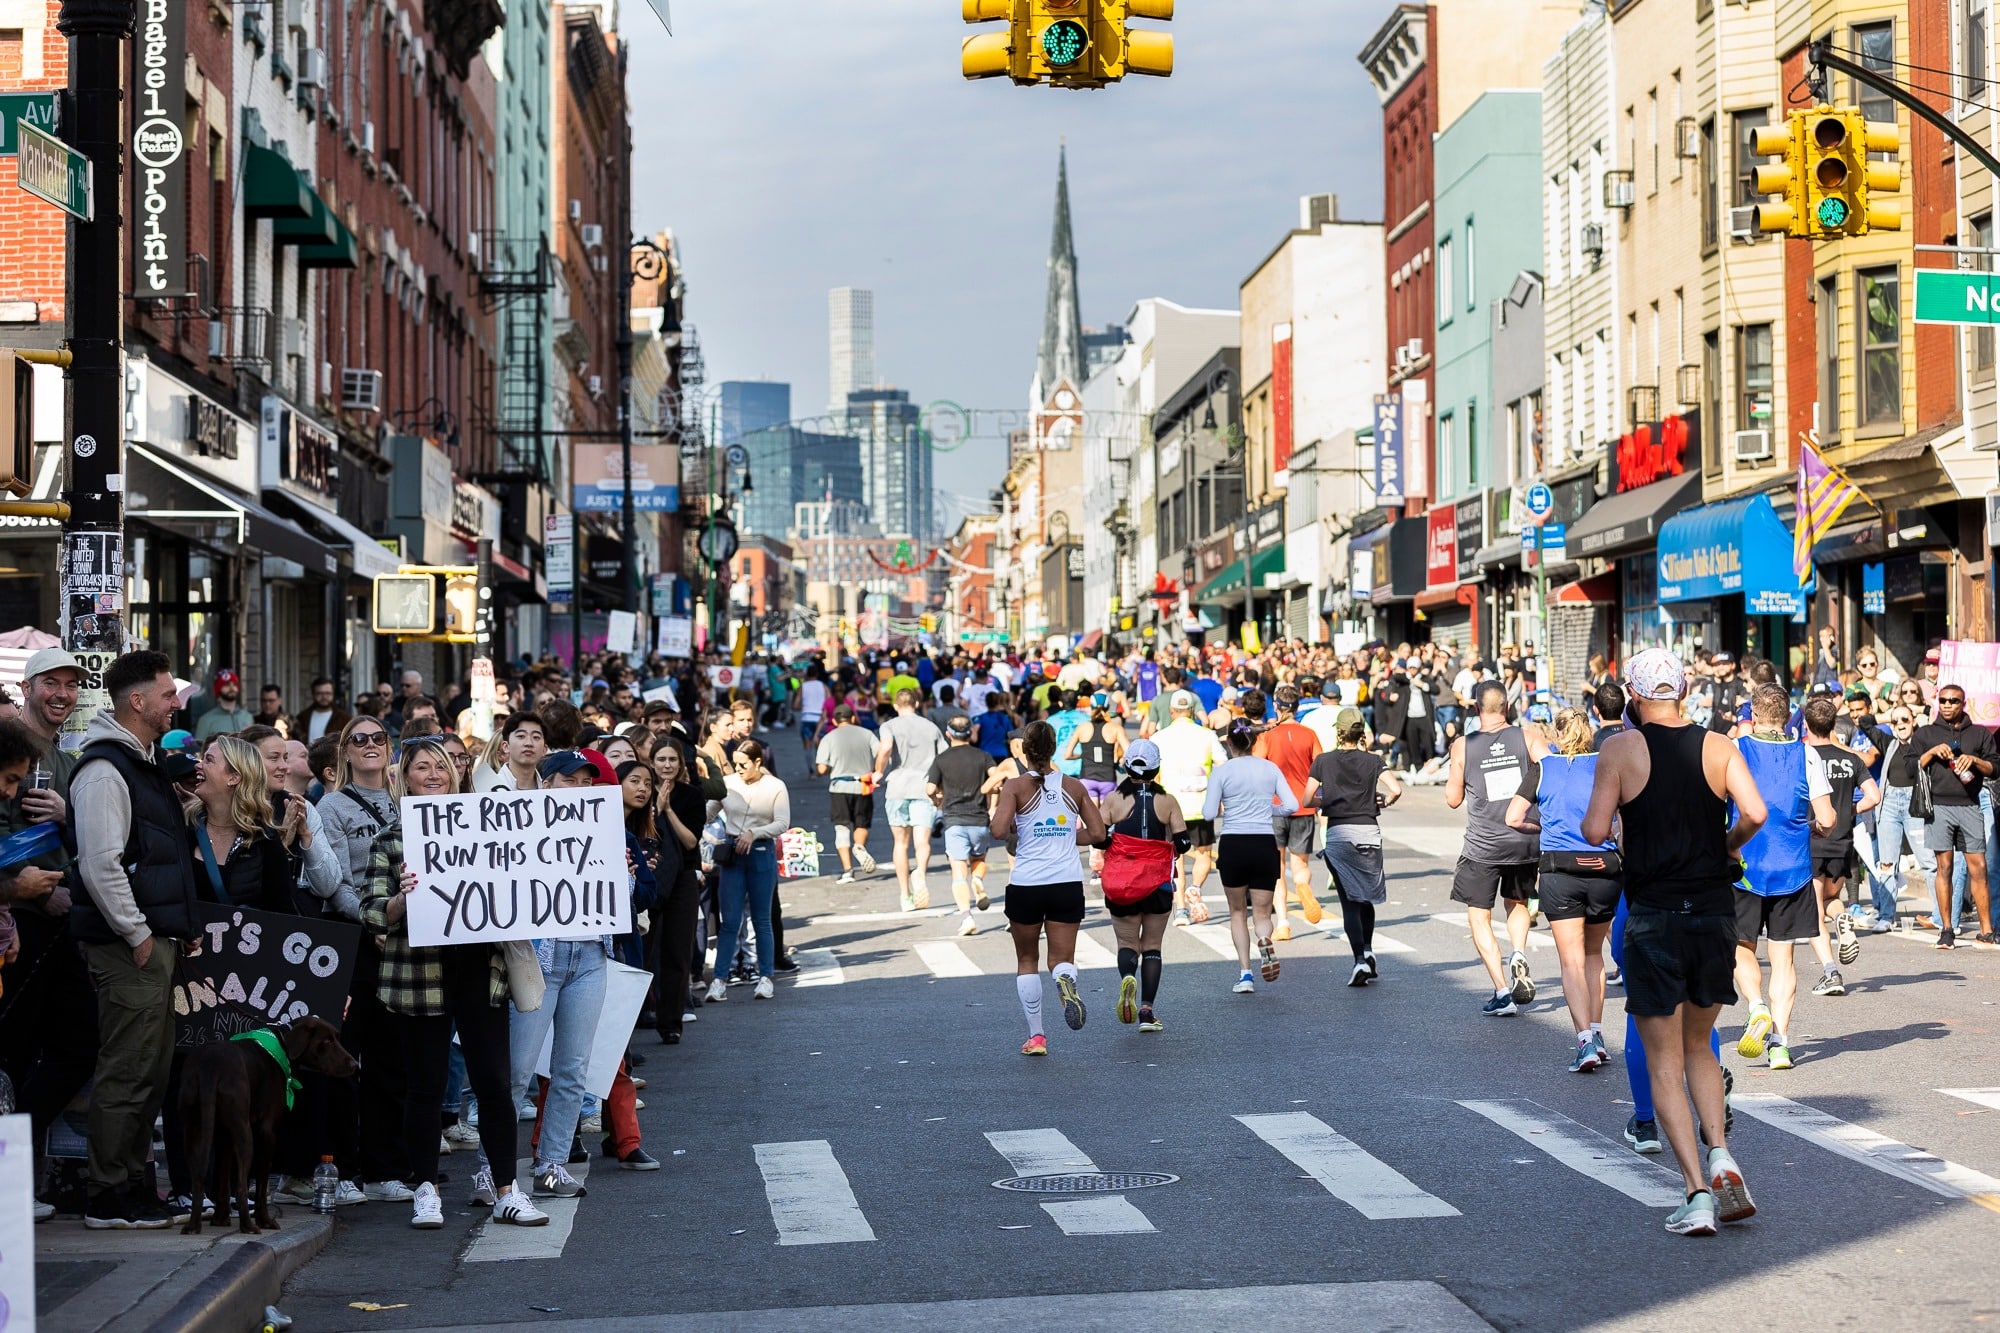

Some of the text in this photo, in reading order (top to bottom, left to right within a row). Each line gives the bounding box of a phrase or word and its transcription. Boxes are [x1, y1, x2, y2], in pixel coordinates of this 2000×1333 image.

[144, 0, 167, 116] Bagel
[141, 131, 176, 144] Bagel
[141, 142, 177, 152] Point
[20, 130, 75, 207] Manhattan
[143, 168, 168, 290] Point
[586, 495, 667, 507] JUST WLK IN
[77, 538, 90, 550] THE
[73, 550, 94, 562] UNITED
[1667, 552, 1693, 582] Wisdom
[1693, 547, 1709, 578] Nails
[1715, 544, 1728, 582] Spa
[1728, 542, 1741, 572] Inc.
[73, 562, 92, 574] RONIN
[1760, 590, 1791, 599] Wisdom
[1046, 793, 1057, 801] CF
[413, 802, 469, 836] THE
[479, 796, 533, 832] RATS
[424, 841, 478, 874] RUN
[484, 841, 526, 872] THIS
[429, 878, 617, 938] YOU DO!!!
[282, 931, 339, 978] GO
